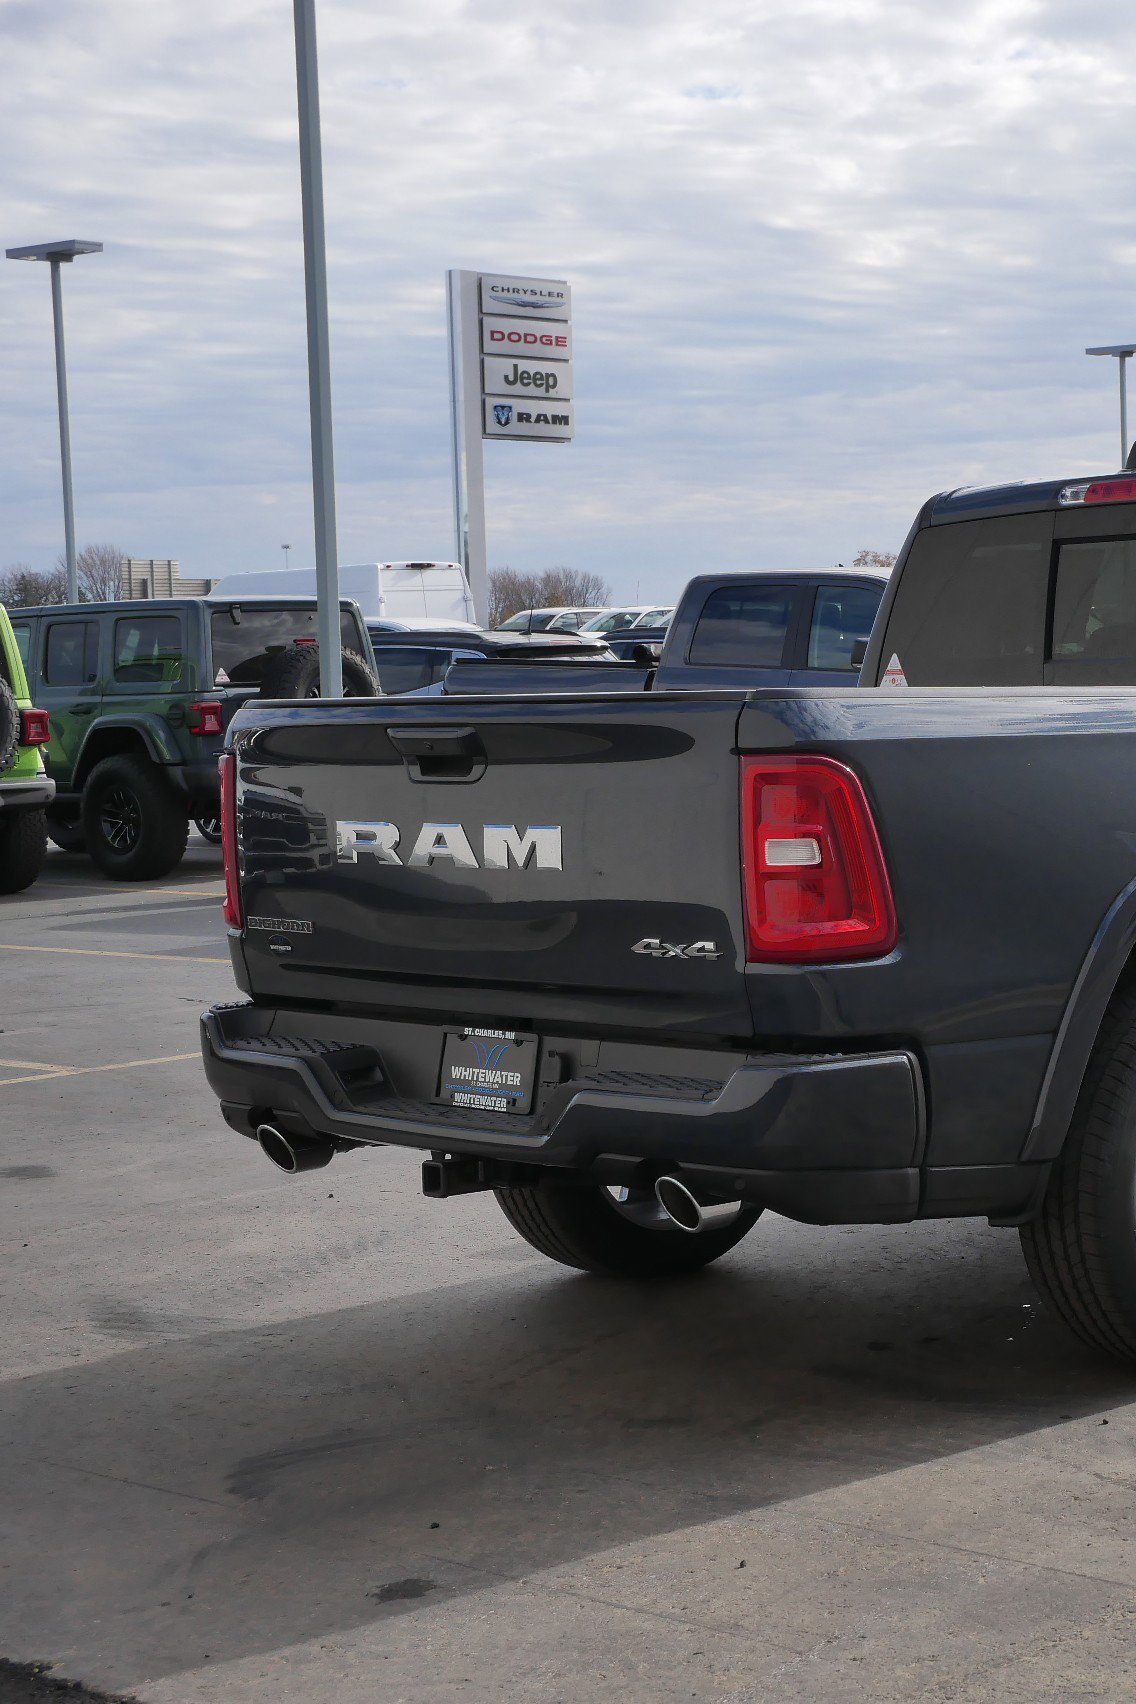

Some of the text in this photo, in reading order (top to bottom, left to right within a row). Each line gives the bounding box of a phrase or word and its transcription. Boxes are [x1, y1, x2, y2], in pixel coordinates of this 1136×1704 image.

[490, 285, 564, 299] CHRYSLER
[490, 329, 567, 347] DODGE
[503, 363, 558, 393] Jeep
[516, 411, 570, 426] RAM
[336, 820, 564, 871] RAM
[451, 1066, 521, 1085] WHITEWATER
[454, 1093, 507, 1107] WHITEWATER
